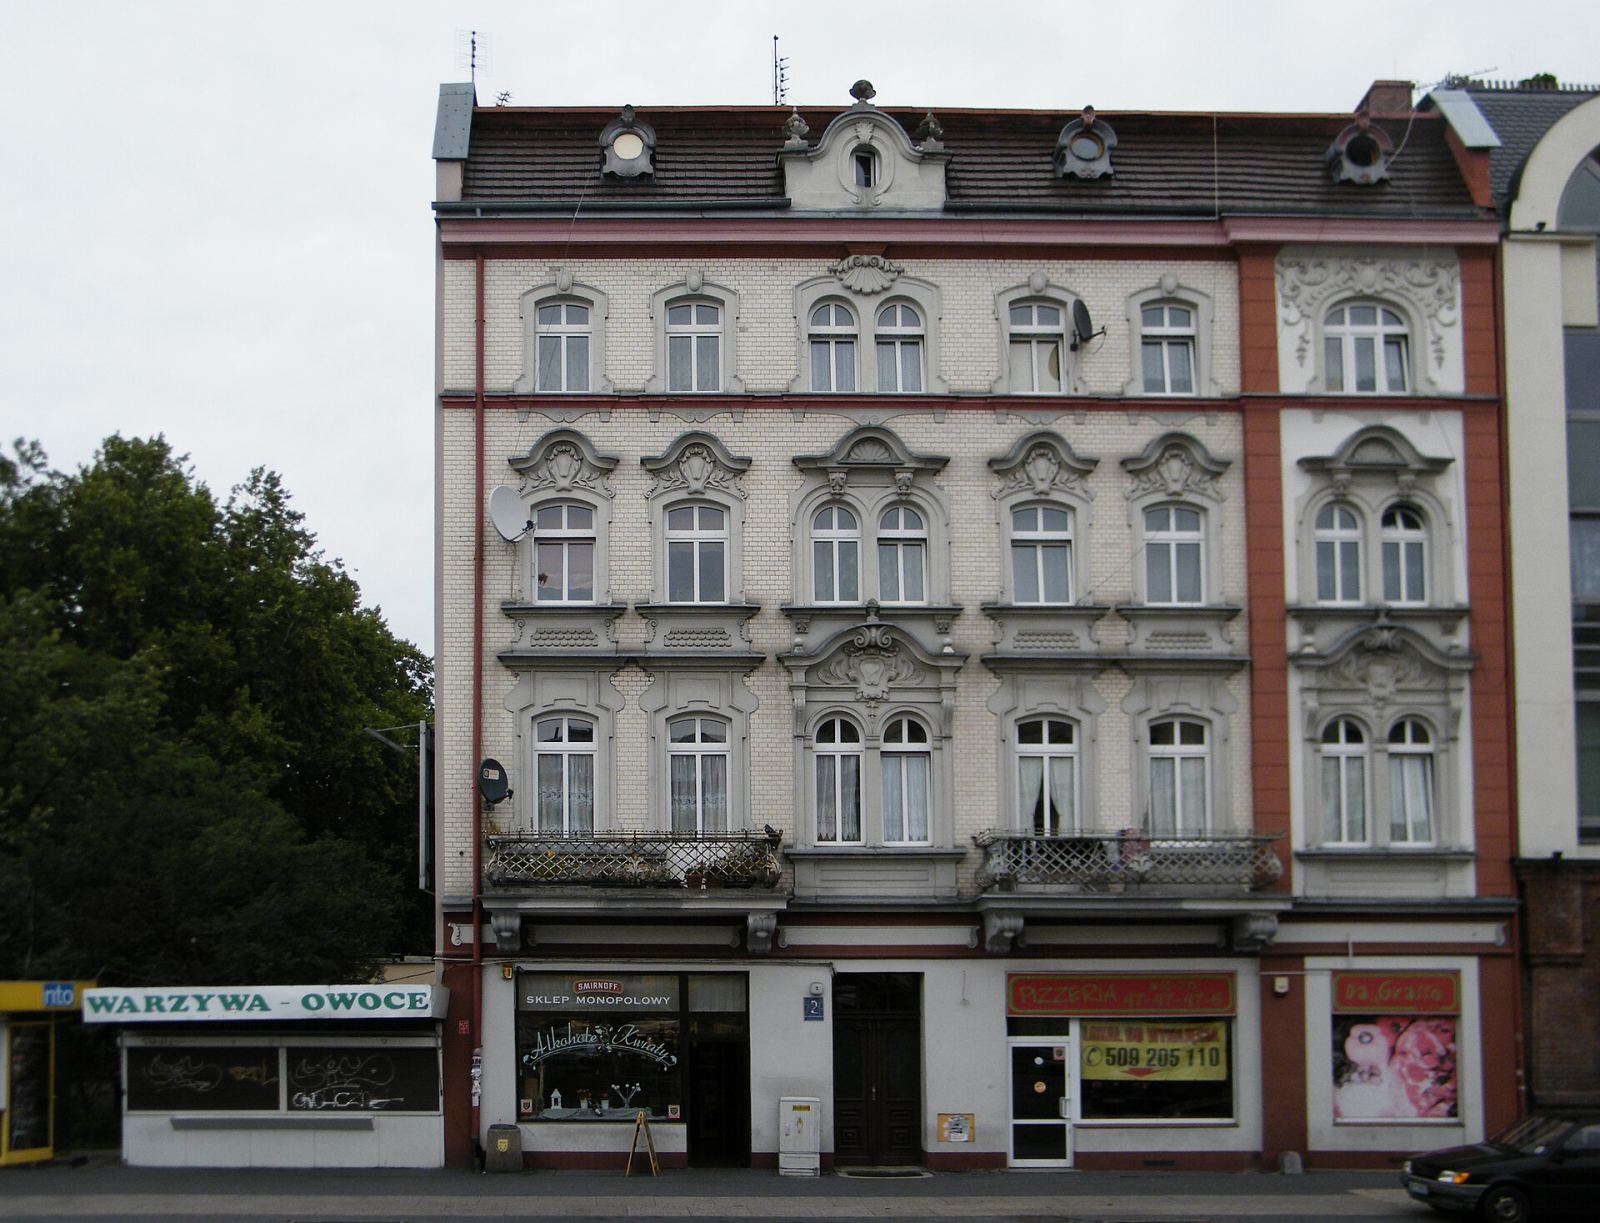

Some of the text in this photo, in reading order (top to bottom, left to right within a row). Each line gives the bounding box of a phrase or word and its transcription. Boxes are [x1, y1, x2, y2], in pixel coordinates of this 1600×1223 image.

[577, 981, 619, 991] SMIRNOFF
[1018, 982, 1118, 1004] PIZZERIA
[86, 993, 272, 1014] WARZYWA
[300, 991, 429, 1011] OWOCE
[526, 995, 671, 1005] SKLEP MONOPOLOWY
[810, 999, 819, 1014] 2
[611, 1023, 669, 1062] Kwiaty
[1104, 1046, 1221, 1068] 509 205 110
